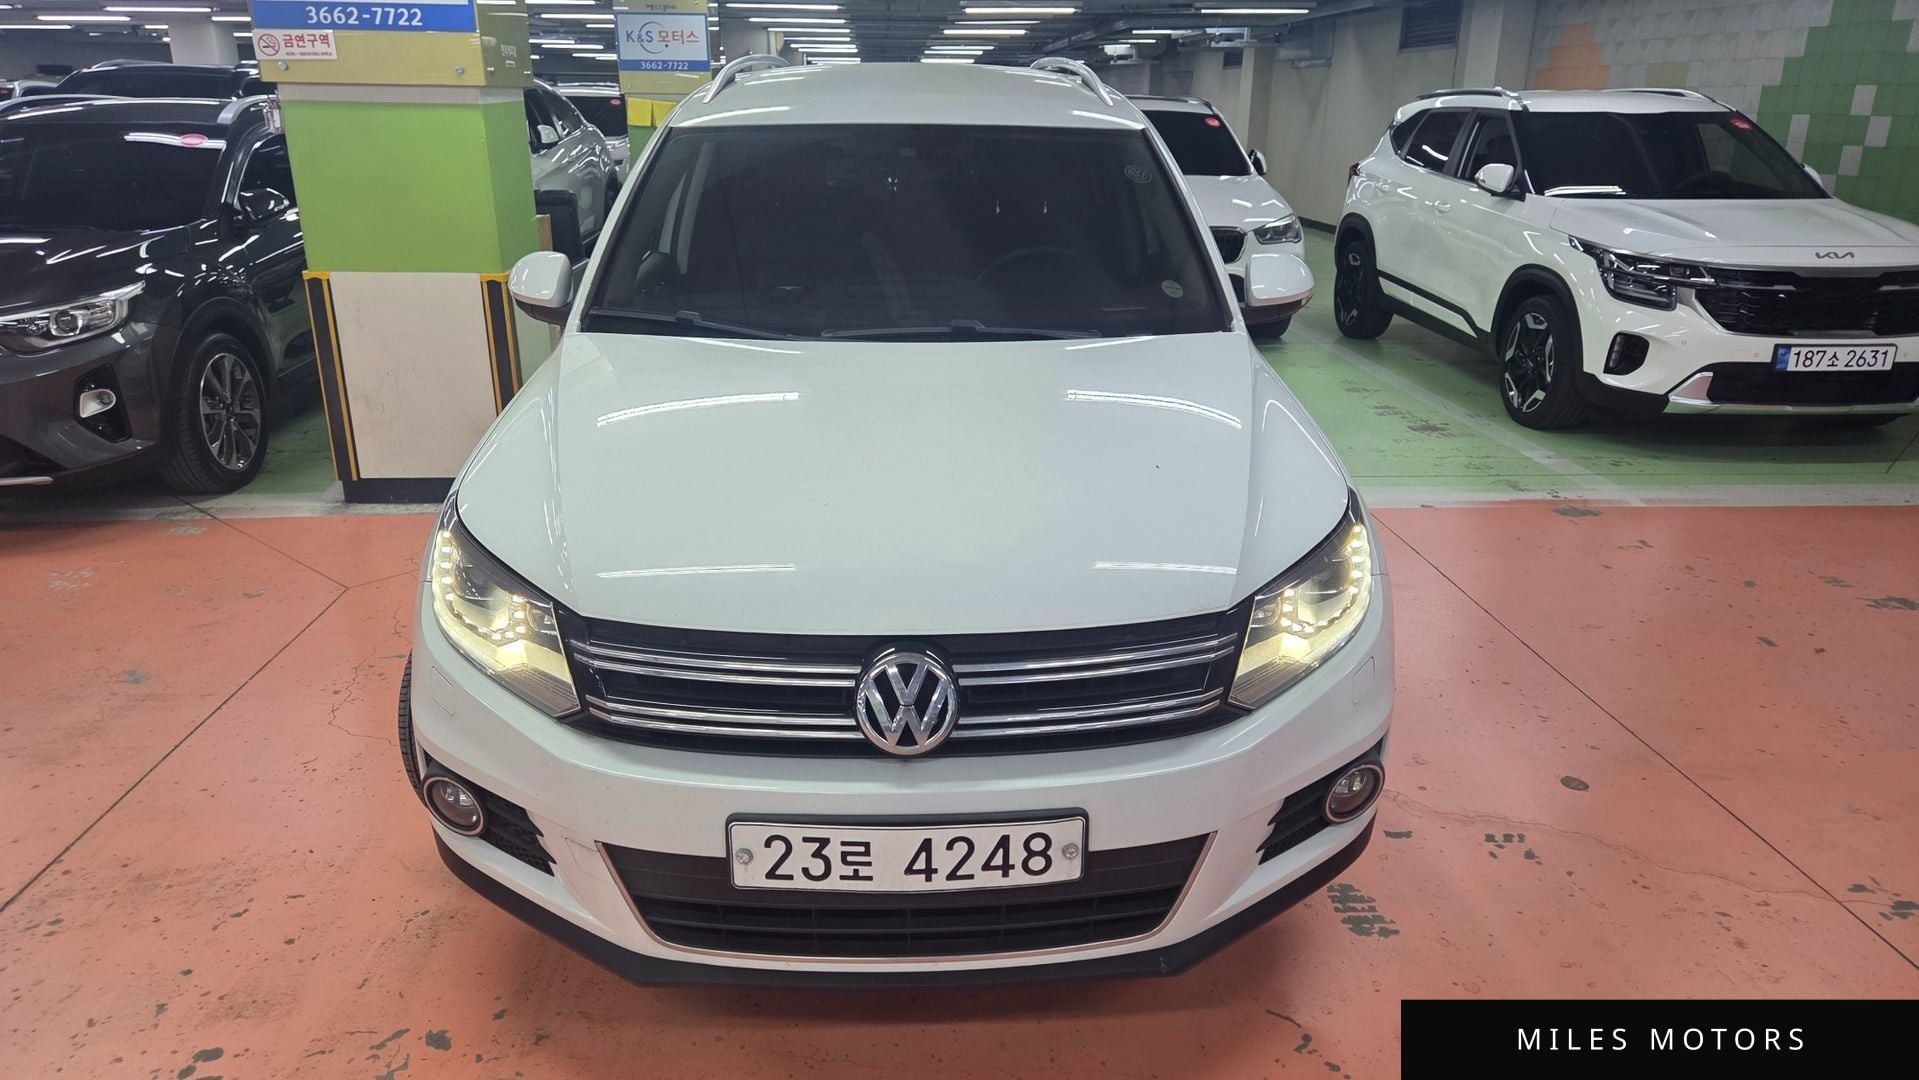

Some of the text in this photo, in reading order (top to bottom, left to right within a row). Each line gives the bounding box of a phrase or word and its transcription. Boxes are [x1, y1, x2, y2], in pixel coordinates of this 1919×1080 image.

[306, 7, 423, 26] 3662-7722
[282, 33, 330, 48] 금연구역
[626, 30, 699, 45] K&S 모터스
[640, 61, 689, 70] 3662-7722
[1793, 350, 1888, 368] 187소 2631
[857, 652, 957, 755] VW
[763, 832, 1053, 882] 23로 4248
